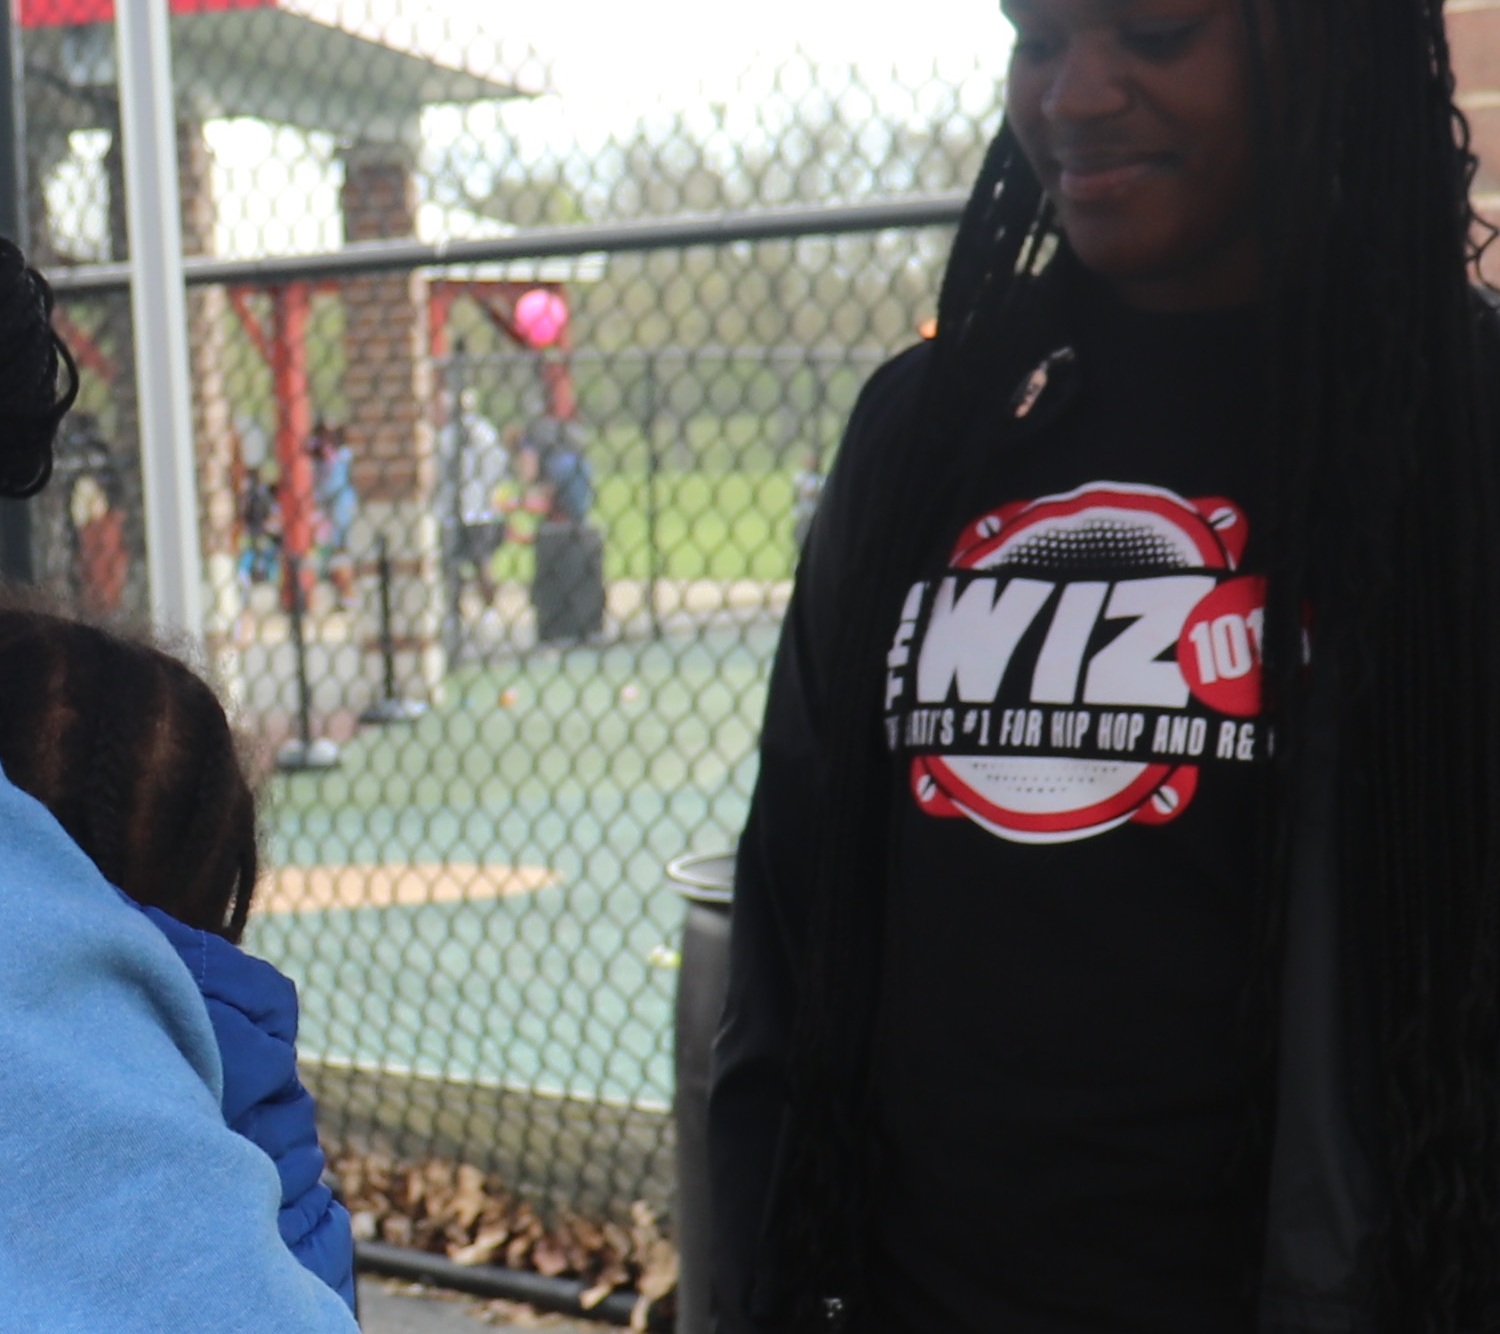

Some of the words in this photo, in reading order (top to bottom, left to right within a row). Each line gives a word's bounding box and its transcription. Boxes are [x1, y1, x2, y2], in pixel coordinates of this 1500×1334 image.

[916, 571, 1218, 709] WIZ
[1000, 708, 1043, 748] FOR
[1050, 710, 1091, 749] HIP
[1097, 712, 1145, 752] HOP
[1151, 715, 1208, 756] AND
